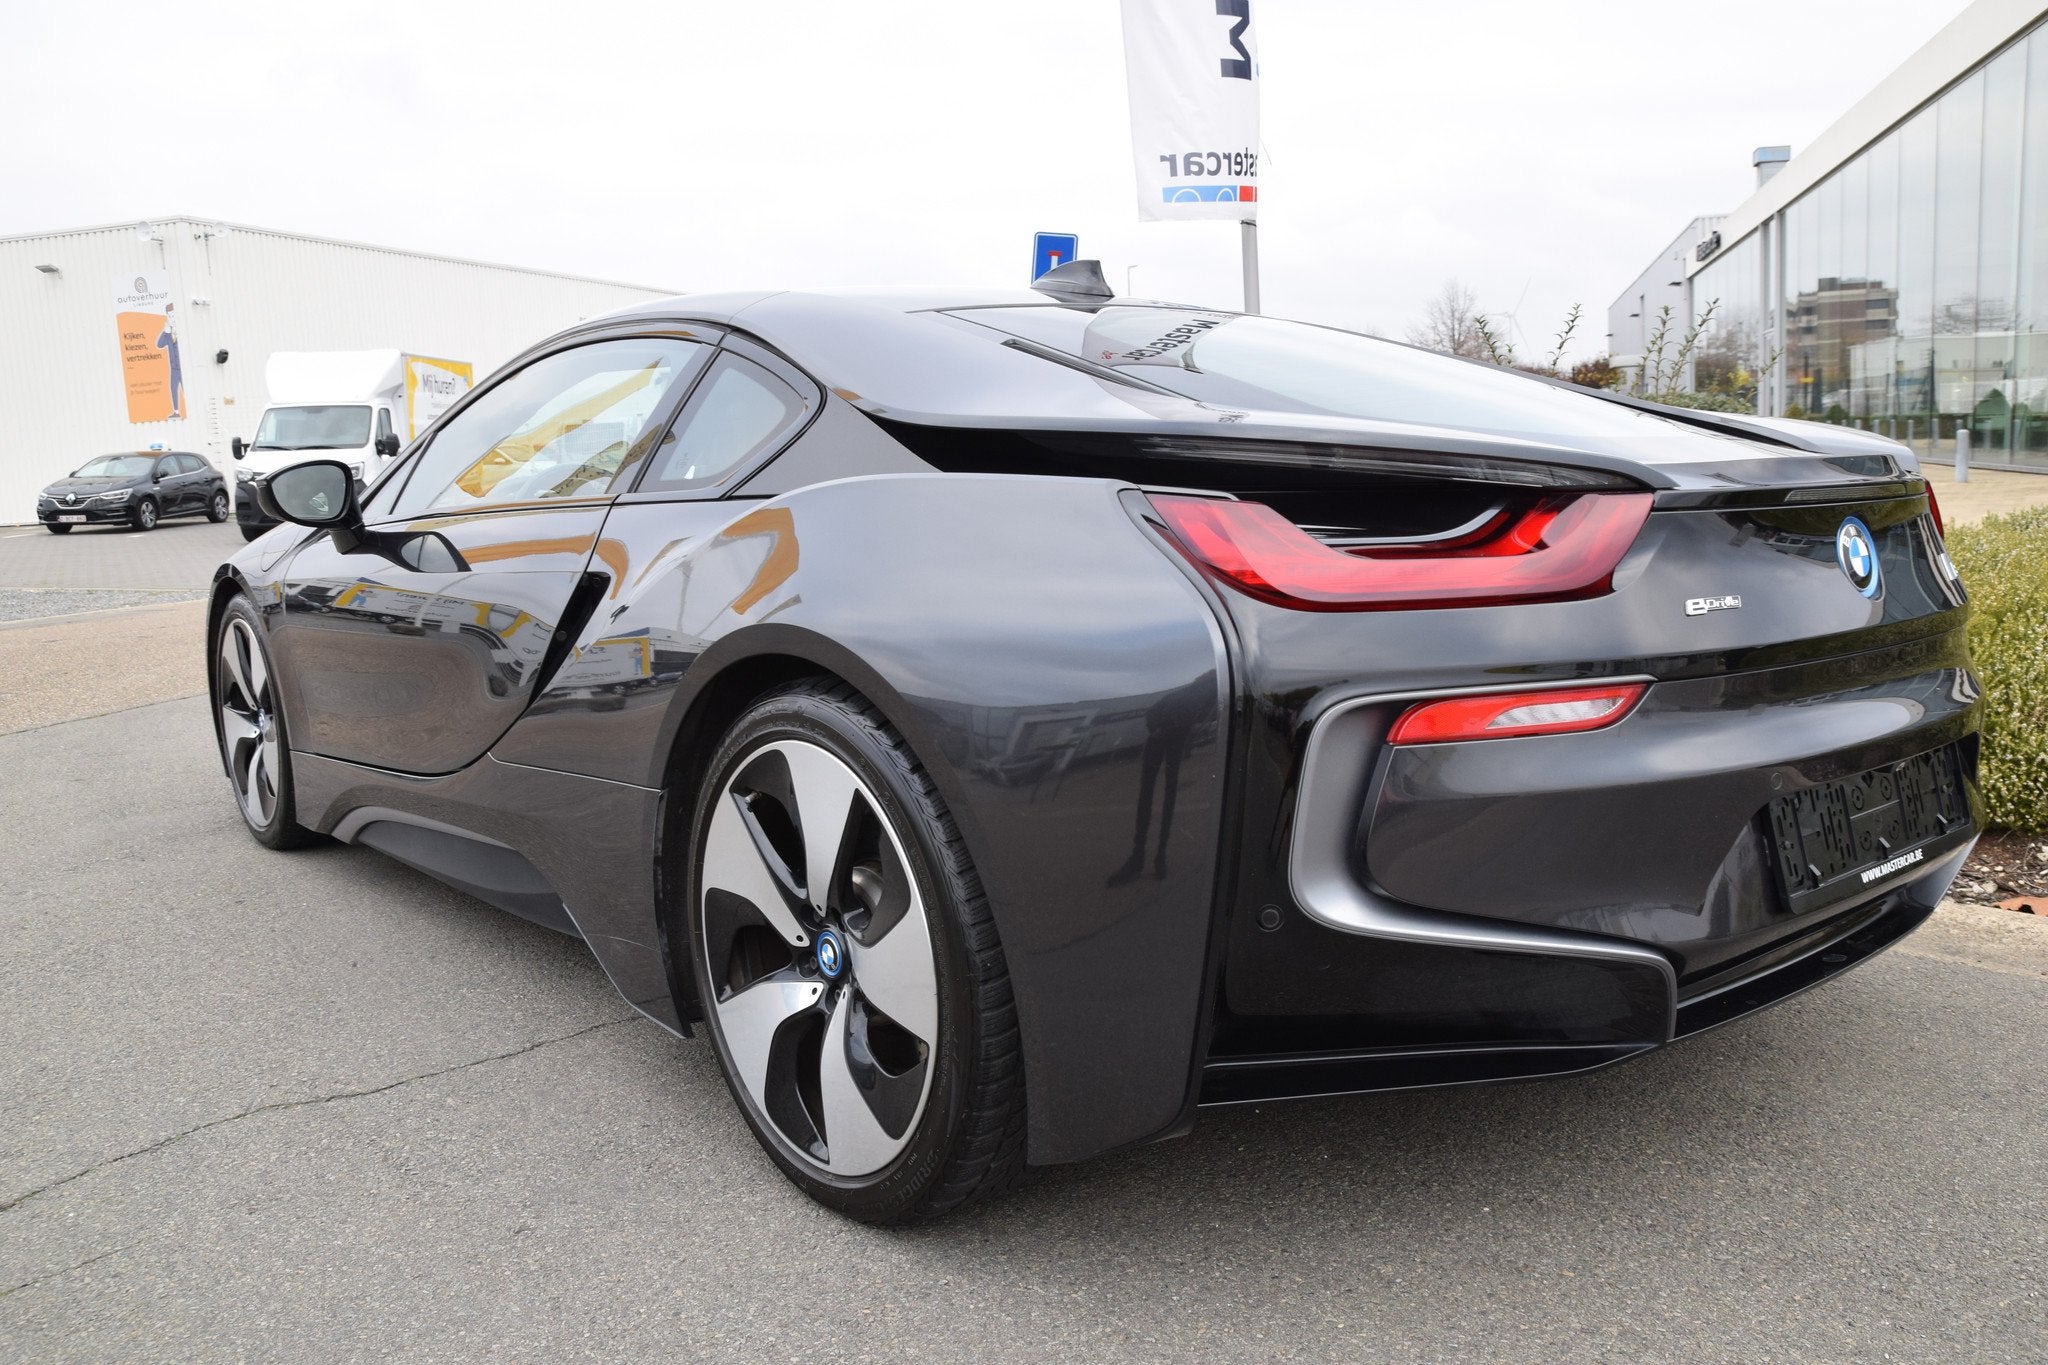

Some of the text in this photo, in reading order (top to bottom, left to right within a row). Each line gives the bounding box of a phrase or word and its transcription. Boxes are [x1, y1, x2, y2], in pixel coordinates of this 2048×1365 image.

[117, 292, 169, 304] autoverhuur
[422, 373, 433, 399] Mij
[1860, 848, 1924, 884] WWW.MASTERCAR.BE
